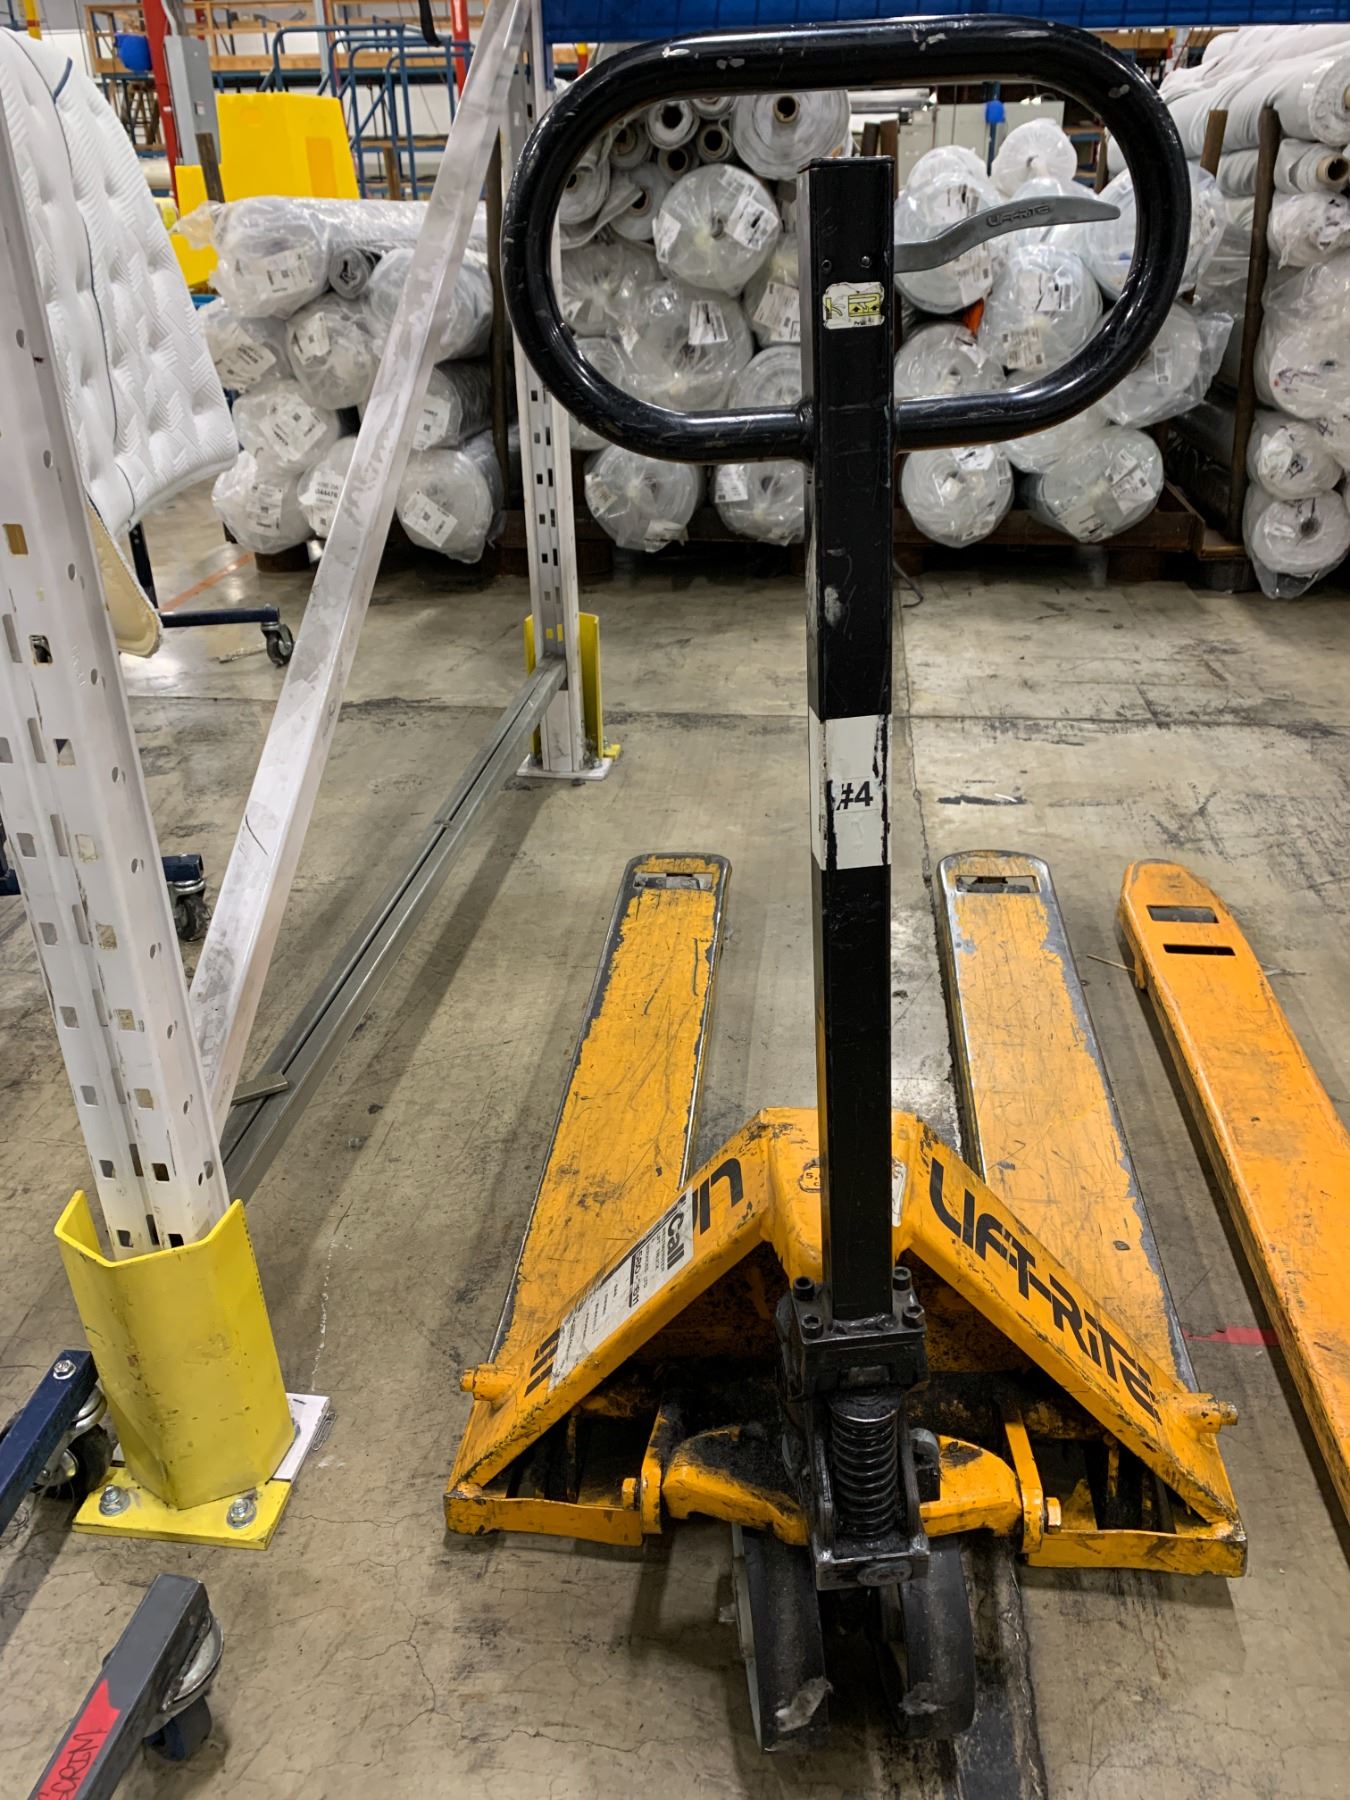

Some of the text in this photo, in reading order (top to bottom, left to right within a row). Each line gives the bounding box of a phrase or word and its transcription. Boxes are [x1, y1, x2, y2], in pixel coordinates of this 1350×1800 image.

[835, 780, 874, 811] #4
[667, 1212, 684, 1270] Call
[929, 1156, 1162, 1425] LIFT-RITE
